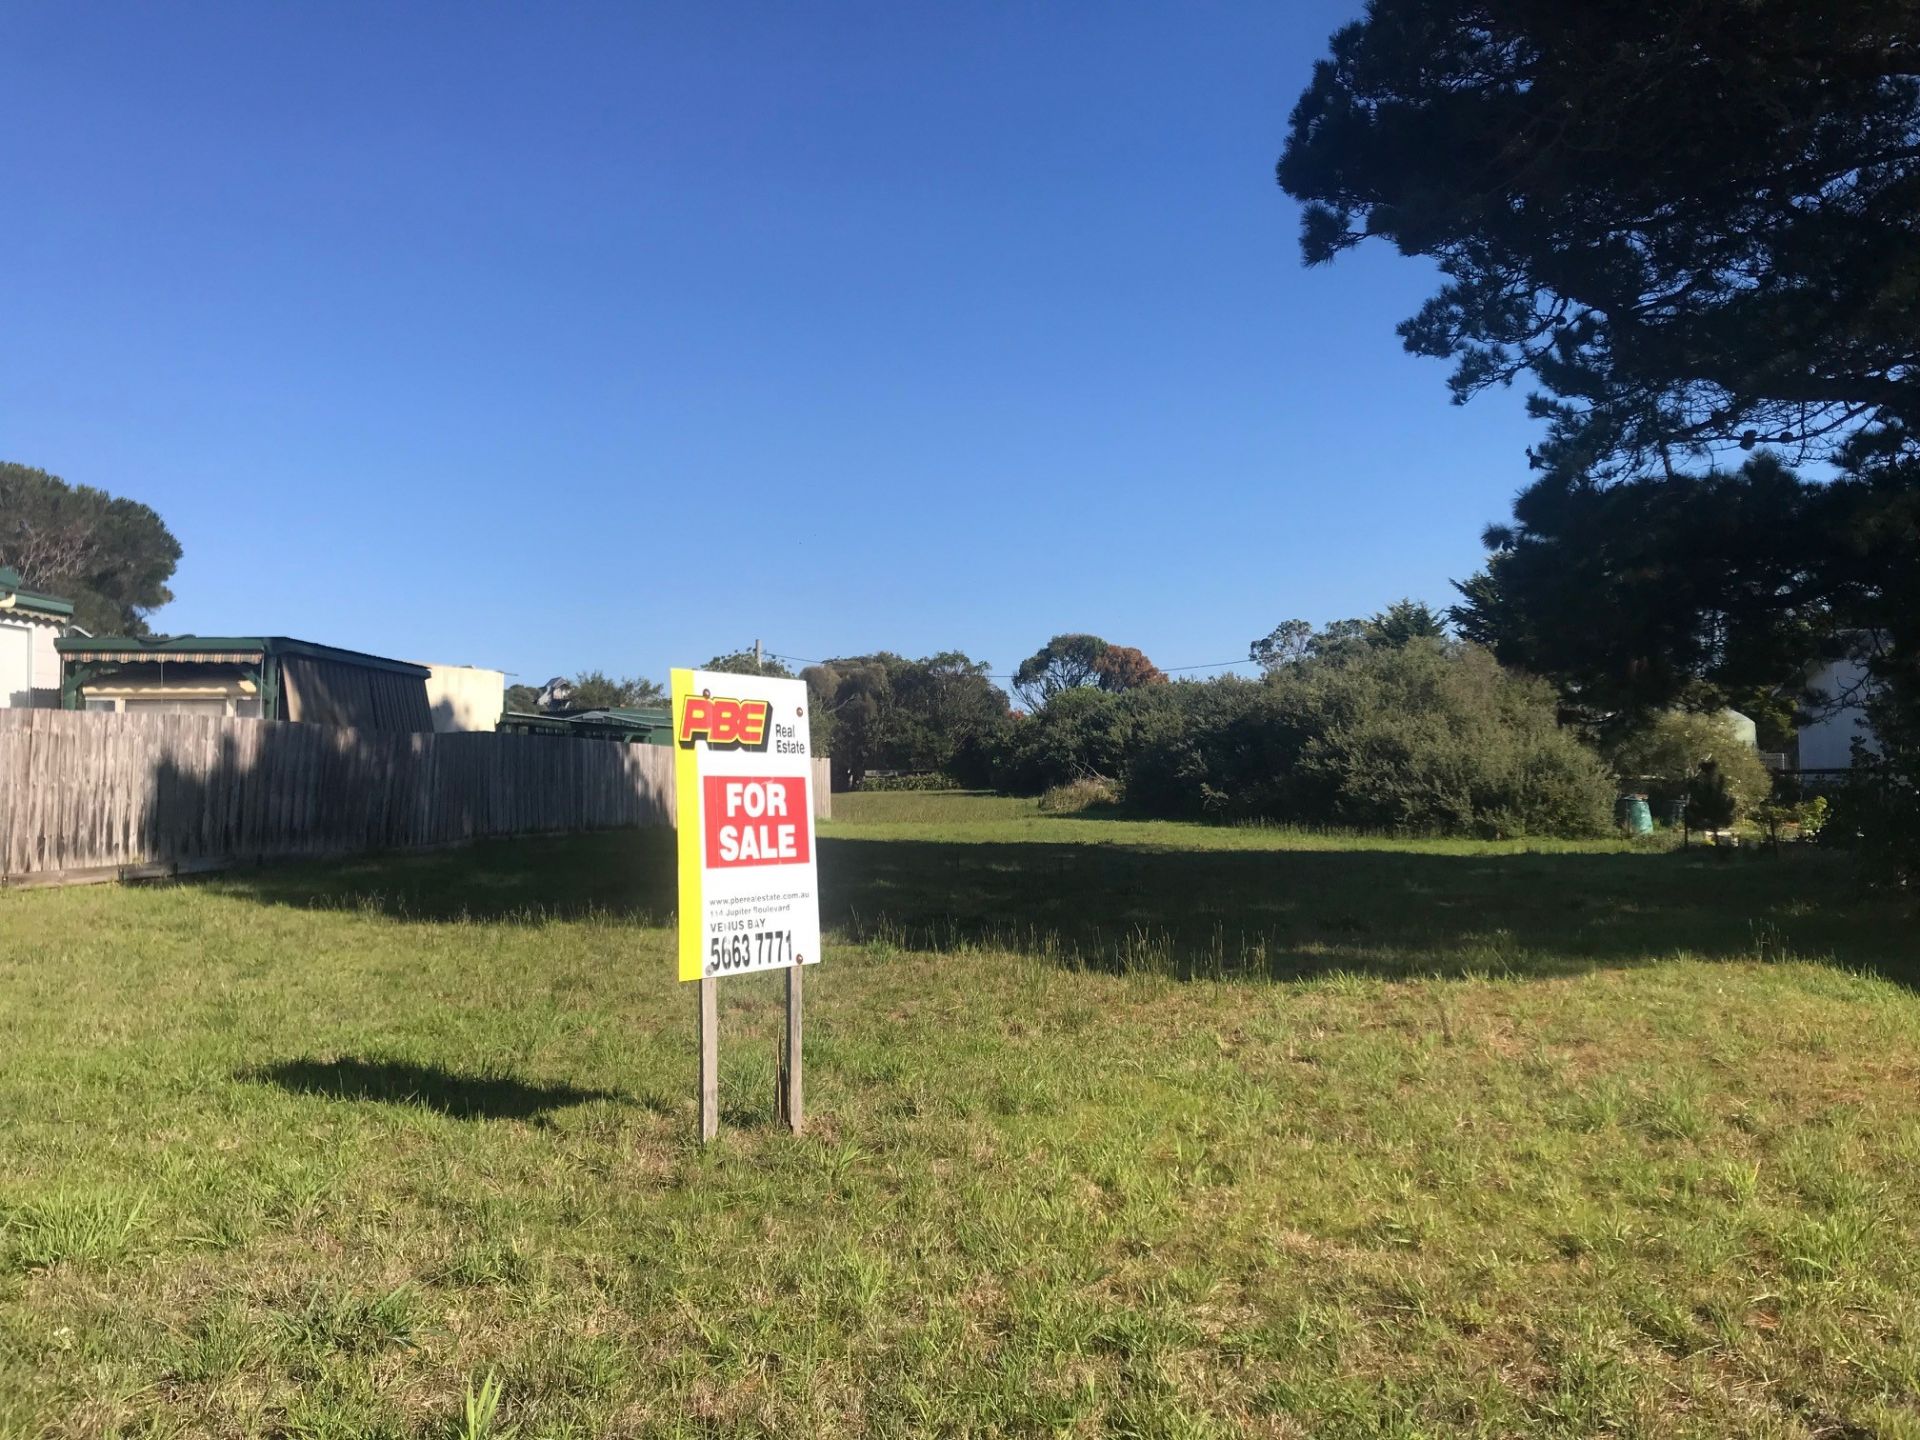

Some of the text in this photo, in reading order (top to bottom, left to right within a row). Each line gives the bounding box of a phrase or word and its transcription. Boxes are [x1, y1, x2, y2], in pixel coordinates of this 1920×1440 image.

[679, 695, 773, 752] PBE
[775, 724, 796, 738] Real
[776, 740, 805, 755] Estate
[726, 782, 787, 818] FOR
[719, 824, 797, 861] SALE
[709, 891, 810, 906] www.pberealestate.com.au
[726, 907, 752, 917] Jupiter
[747, 918, 766, 930] BAY
[710, 929, 792, 971] 5663 7771
